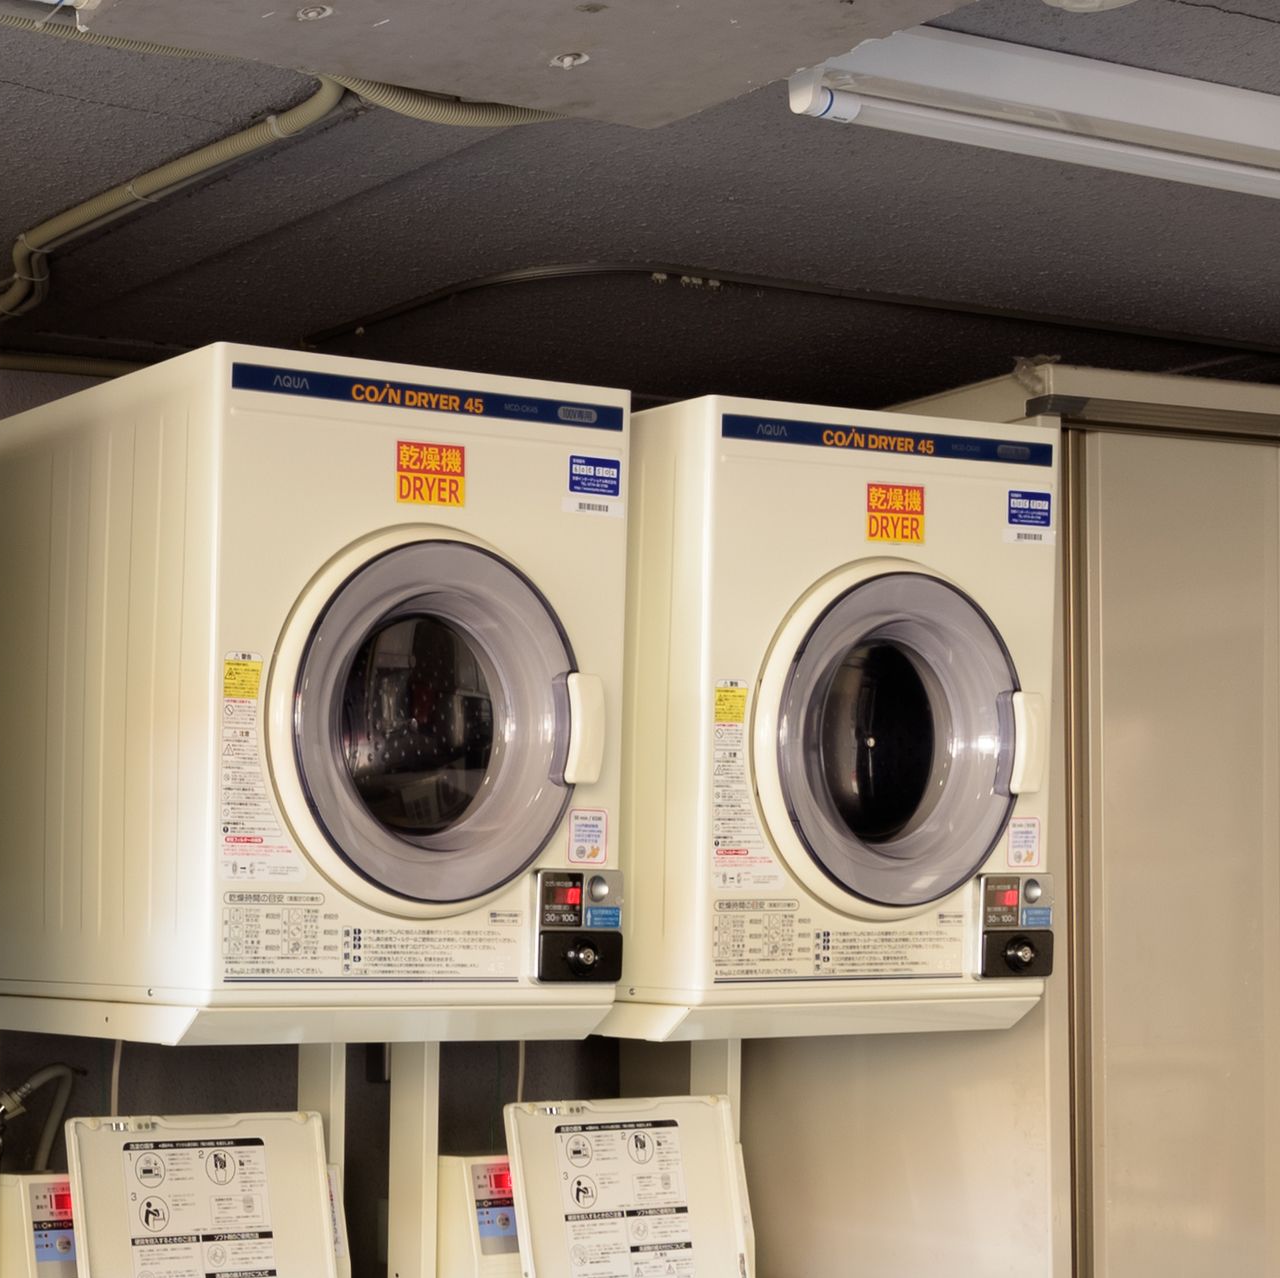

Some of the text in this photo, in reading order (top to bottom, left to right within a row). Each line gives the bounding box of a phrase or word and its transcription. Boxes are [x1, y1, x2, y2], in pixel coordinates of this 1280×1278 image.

[273, 375, 310, 390] AQUA
[351, 383, 483, 414] COIN DRYER 45
[756, 424, 788, 437] AQUA
[822, 428, 934, 455] COIN DRYER 45
[399, 445, 462, 472] 乾燥機
[399, 475, 460, 503] DRYER
[869, 487, 921, 512] 乾燥機
[869, 515, 920, 540] DRYER
